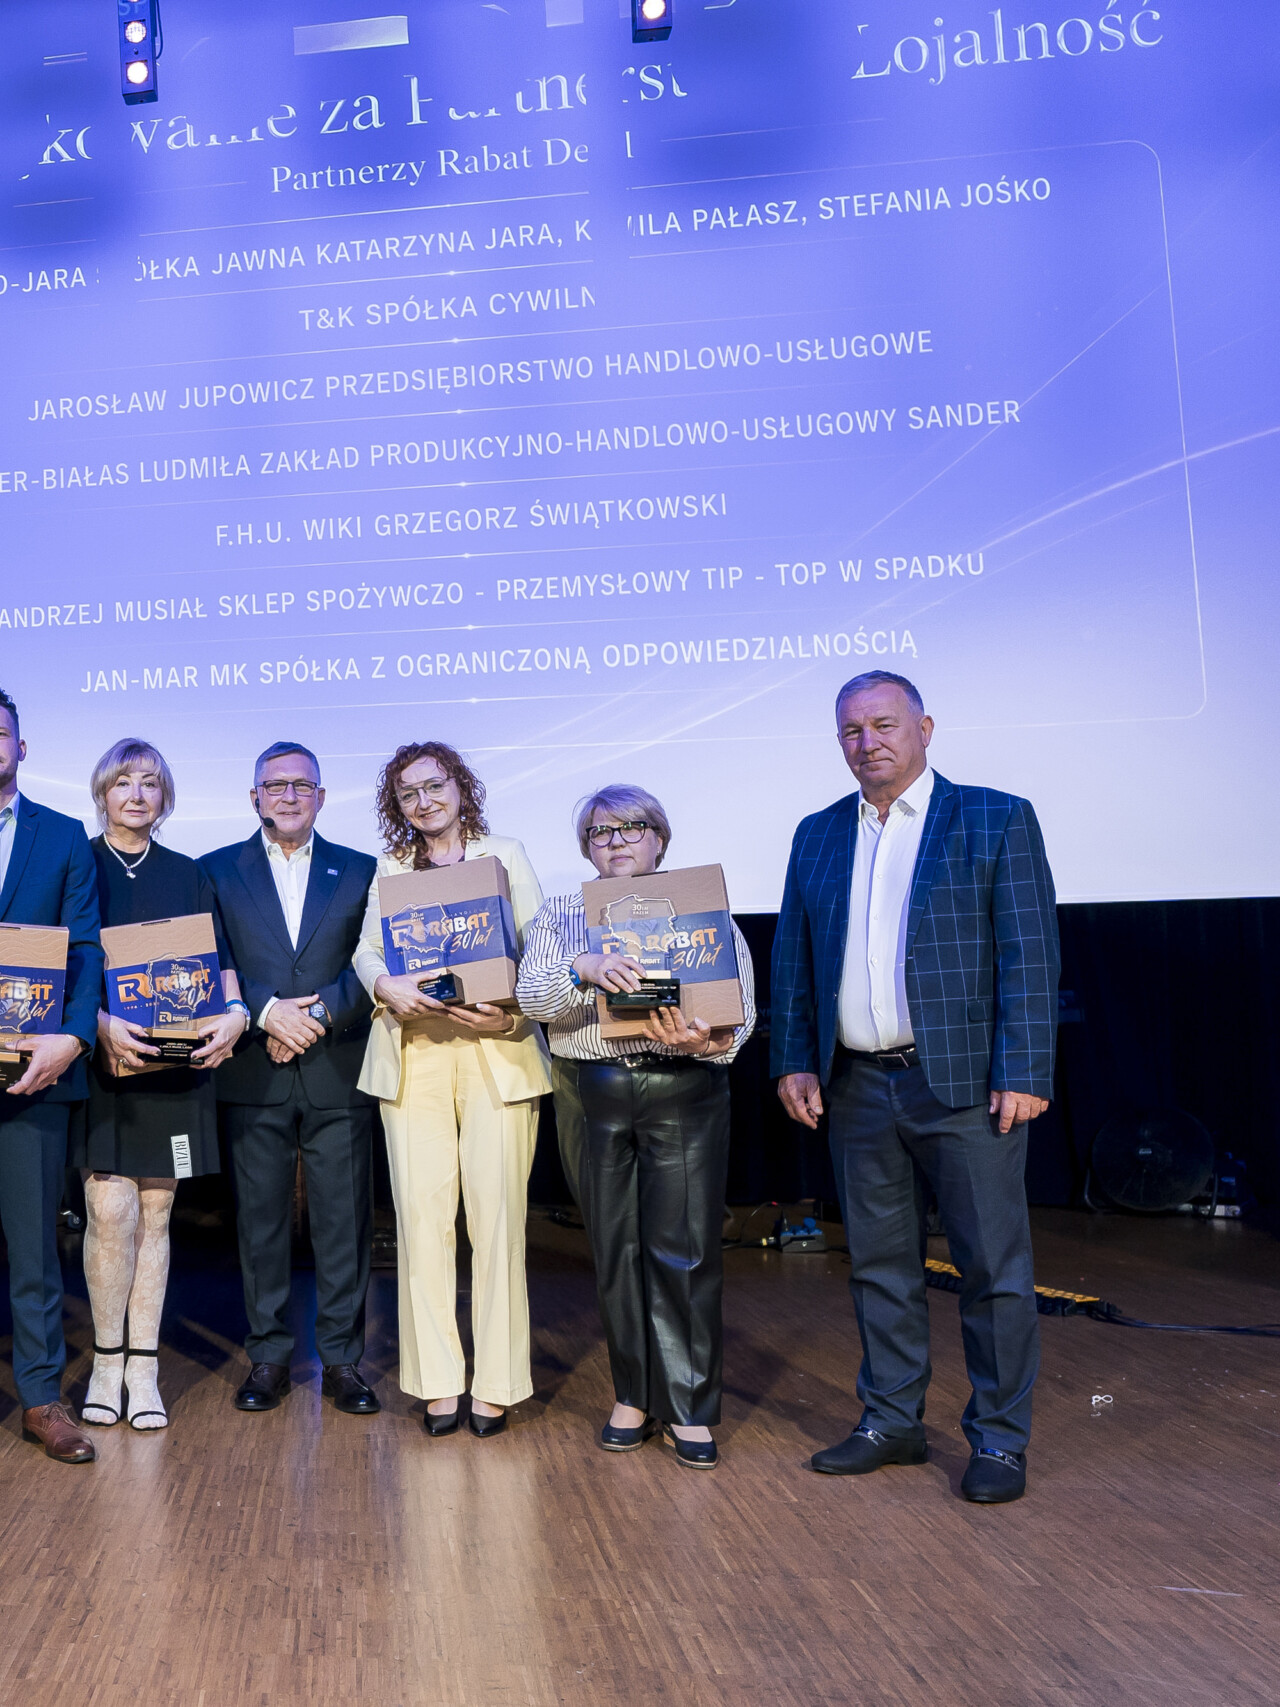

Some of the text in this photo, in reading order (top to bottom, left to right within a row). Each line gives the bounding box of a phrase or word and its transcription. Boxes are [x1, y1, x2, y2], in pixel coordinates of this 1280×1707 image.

[320, 94, 385, 135] za
[272, 158, 426, 193] Partnerzy
[437, 146, 532, 178] Rabat
[212, 246, 306, 275] JAWNA
[316, 229, 475, 265] KATARZYNA
[485, 222, 563, 251] JARA,
[693, 200, 807, 232] PAŁASZ,
[818, 186, 951, 221] STEFANIA
[960, 175, 1051, 208] JOŚKO
[299, 286, 596, 331] T&K SPÓŁKA CYWILN
[28, 329, 934, 422] JAROSŁAW JUPOWICZ PRZEDSIĘBIORSTWO HANDLOWO-USŁUGOWE
[139, 453, 251, 484] LUDMIŁA
[260, 446, 359, 475] ZAKŁAD
[369, 407, 897, 467] PRODUKCYJNO-HANDLOWO-USŁUGOWY
[907, 399, 1021, 430] SANDER
[216, 492, 728, 547] F.H.U. WIKI GRZEGORZ ŚWIĄTKOWSKI
[114, 597, 208, 623] MUSIAŁ
[217, 591, 296, 617] SKLEP
[305, 581, 464, 612] SPOŻYWCZO
[496, 569, 692, 601] PRZEMYSŁOWY
[702, 566, 744, 590] TIP
[774, 561, 827, 587] TOP
[838, 559, 863, 582] W
[874, 552, 985, 582] SPADKU
[80, 626, 919, 694] JAN-MAR MK SPÓŁKA Z OGRANICZONĄ ODPOWIEDZIALNOŚCIĄ
[428, 911, 490, 937] RABAT
[450, 931, 472, 953] 30
[645, 927, 718, 953] RABAT
[672, 948, 698, 972] 30
